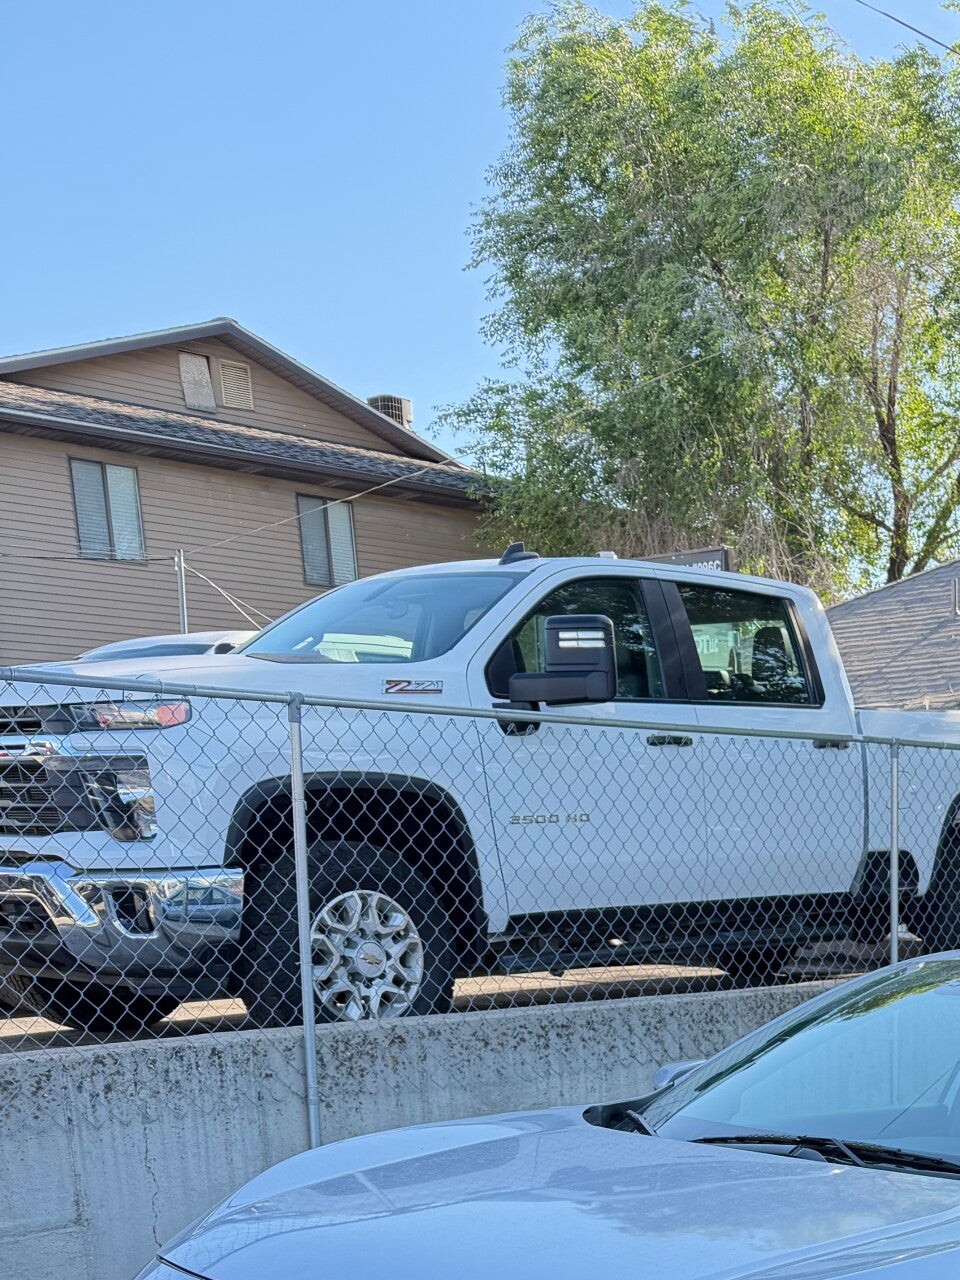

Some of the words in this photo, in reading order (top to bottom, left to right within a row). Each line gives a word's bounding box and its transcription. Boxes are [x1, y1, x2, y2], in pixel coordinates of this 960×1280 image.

[386, 680, 443, 694] Z71
[510, 815, 559, 825] 2500
[566, 813, 590, 823] HD
